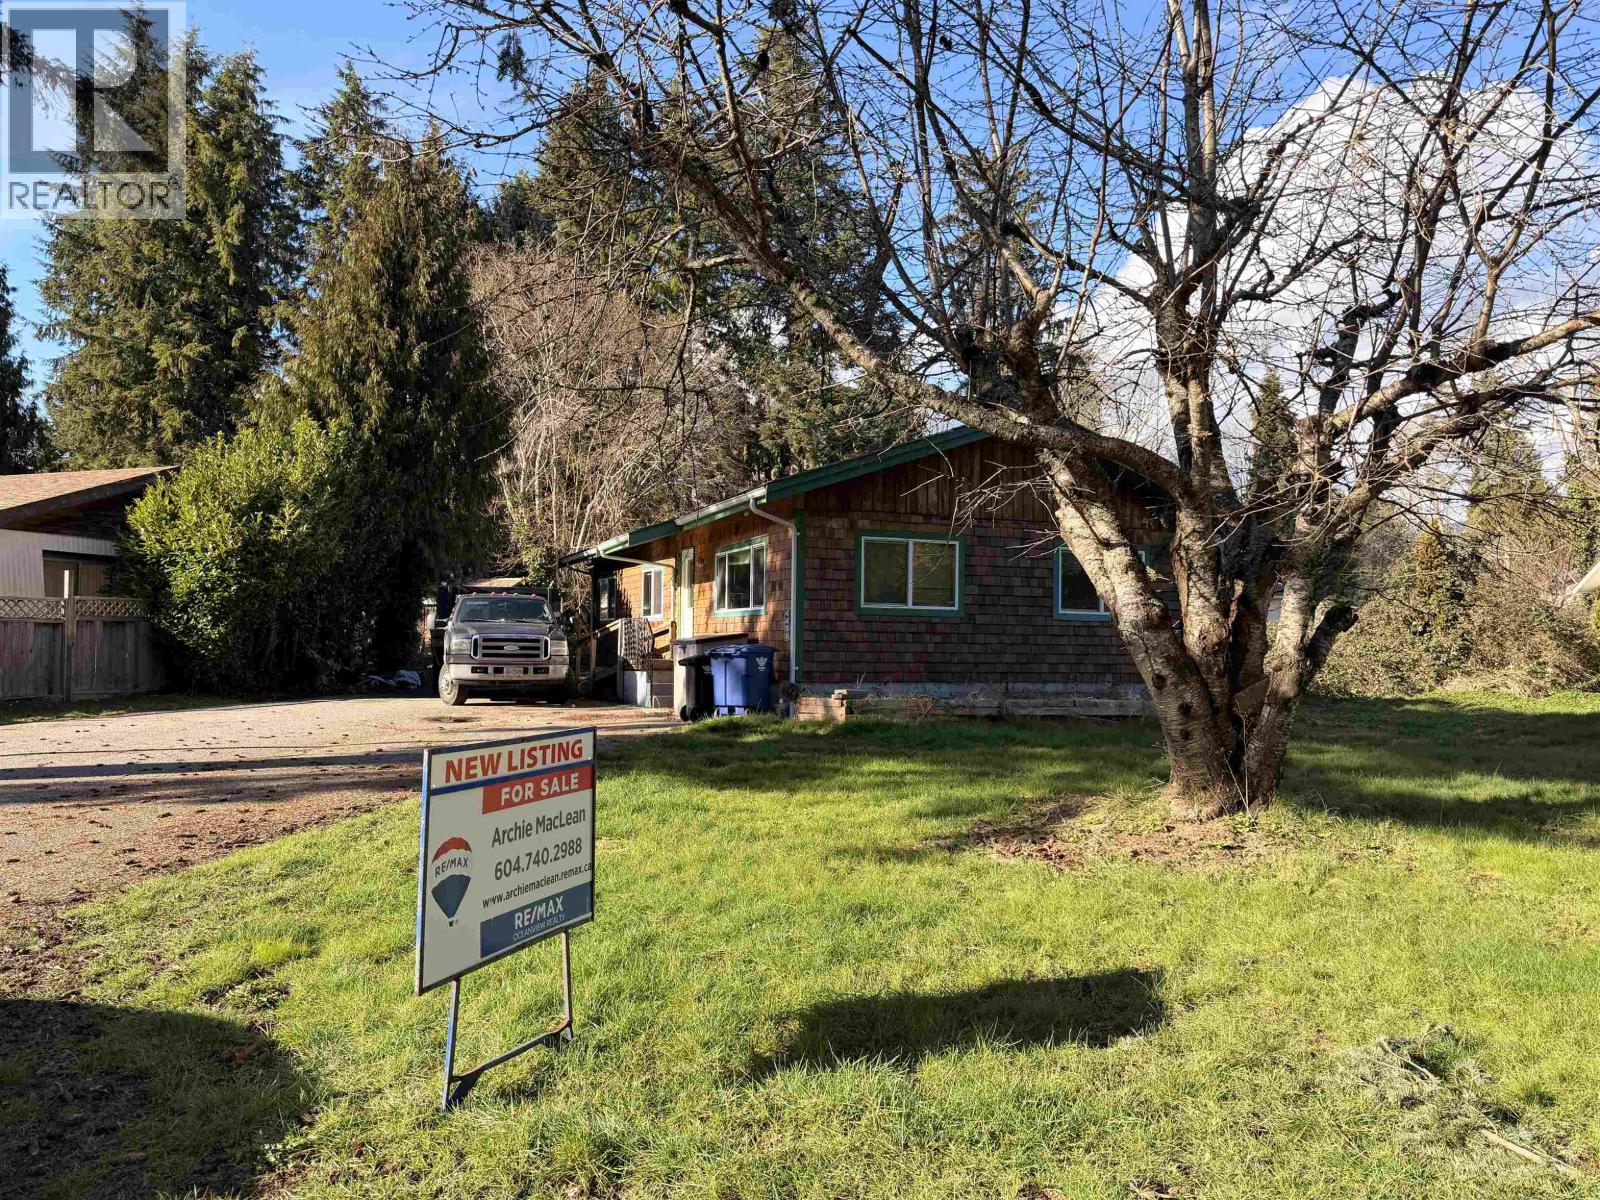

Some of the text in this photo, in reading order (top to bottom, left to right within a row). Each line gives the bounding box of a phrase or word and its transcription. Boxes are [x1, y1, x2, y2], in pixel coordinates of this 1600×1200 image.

[445, 739, 583, 784] NEW LISTING
[501, 772, 579, 806] FOR SALE
[491, 808, 586, 848] Archie MacLean
[435, 857, 469, 878] RE/MAX
[494, 837, 582, 881] 604.740.2988
[482, 862, 592, 908] www.archiemaclean.remax.ca
[512, 914, 566, 941] OCEANVIEW REALTY
[514, 896, 564, 929] RE/MAX
